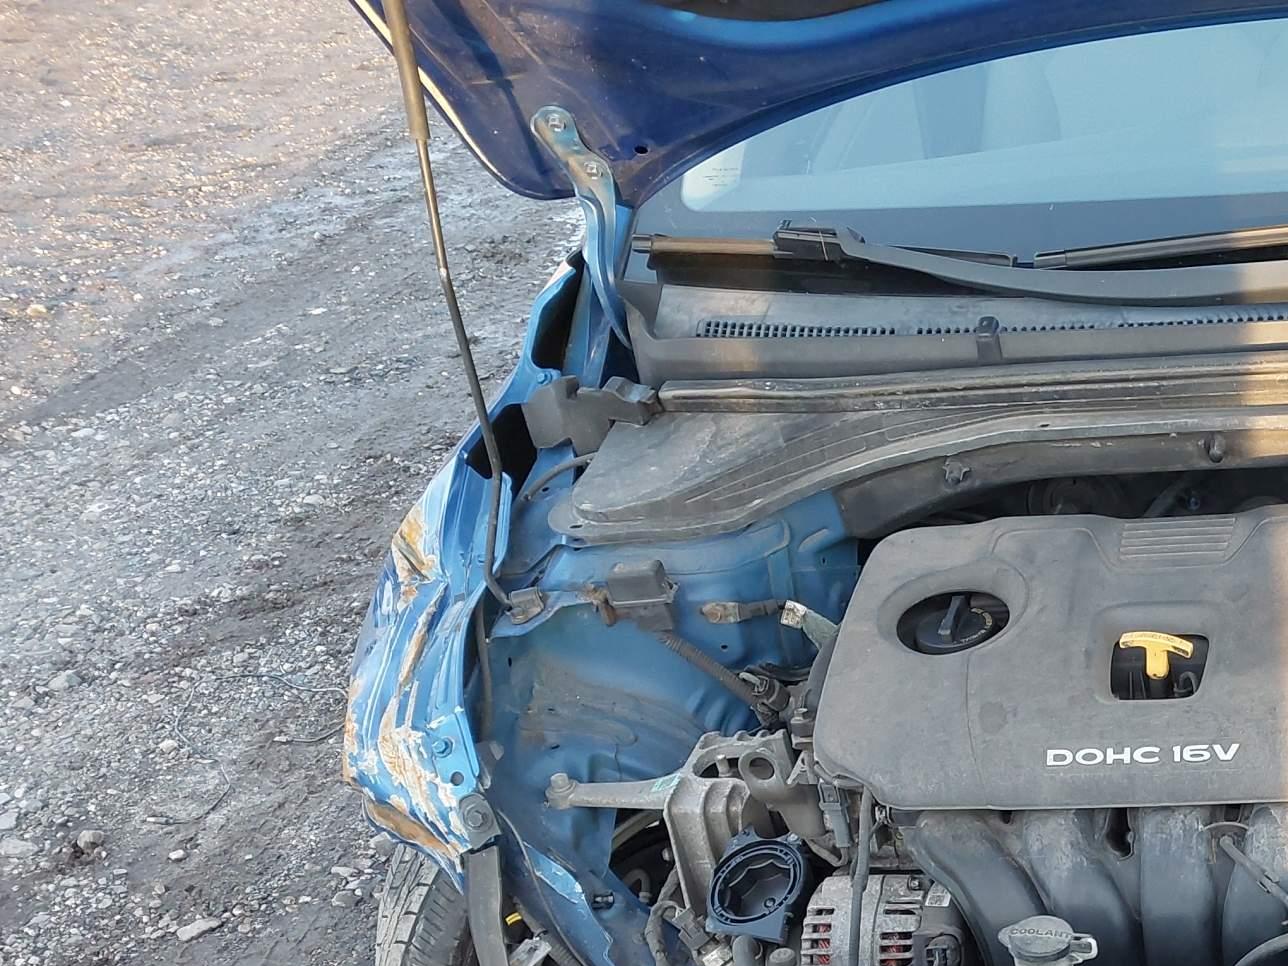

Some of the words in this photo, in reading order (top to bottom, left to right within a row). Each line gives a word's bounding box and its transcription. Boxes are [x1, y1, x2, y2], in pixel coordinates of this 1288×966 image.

[1046, 746, 1161, 766] DOHC
[1172, 743, 1241, 763] 16V
[1009, 927, 1073, 940] COOLANT
